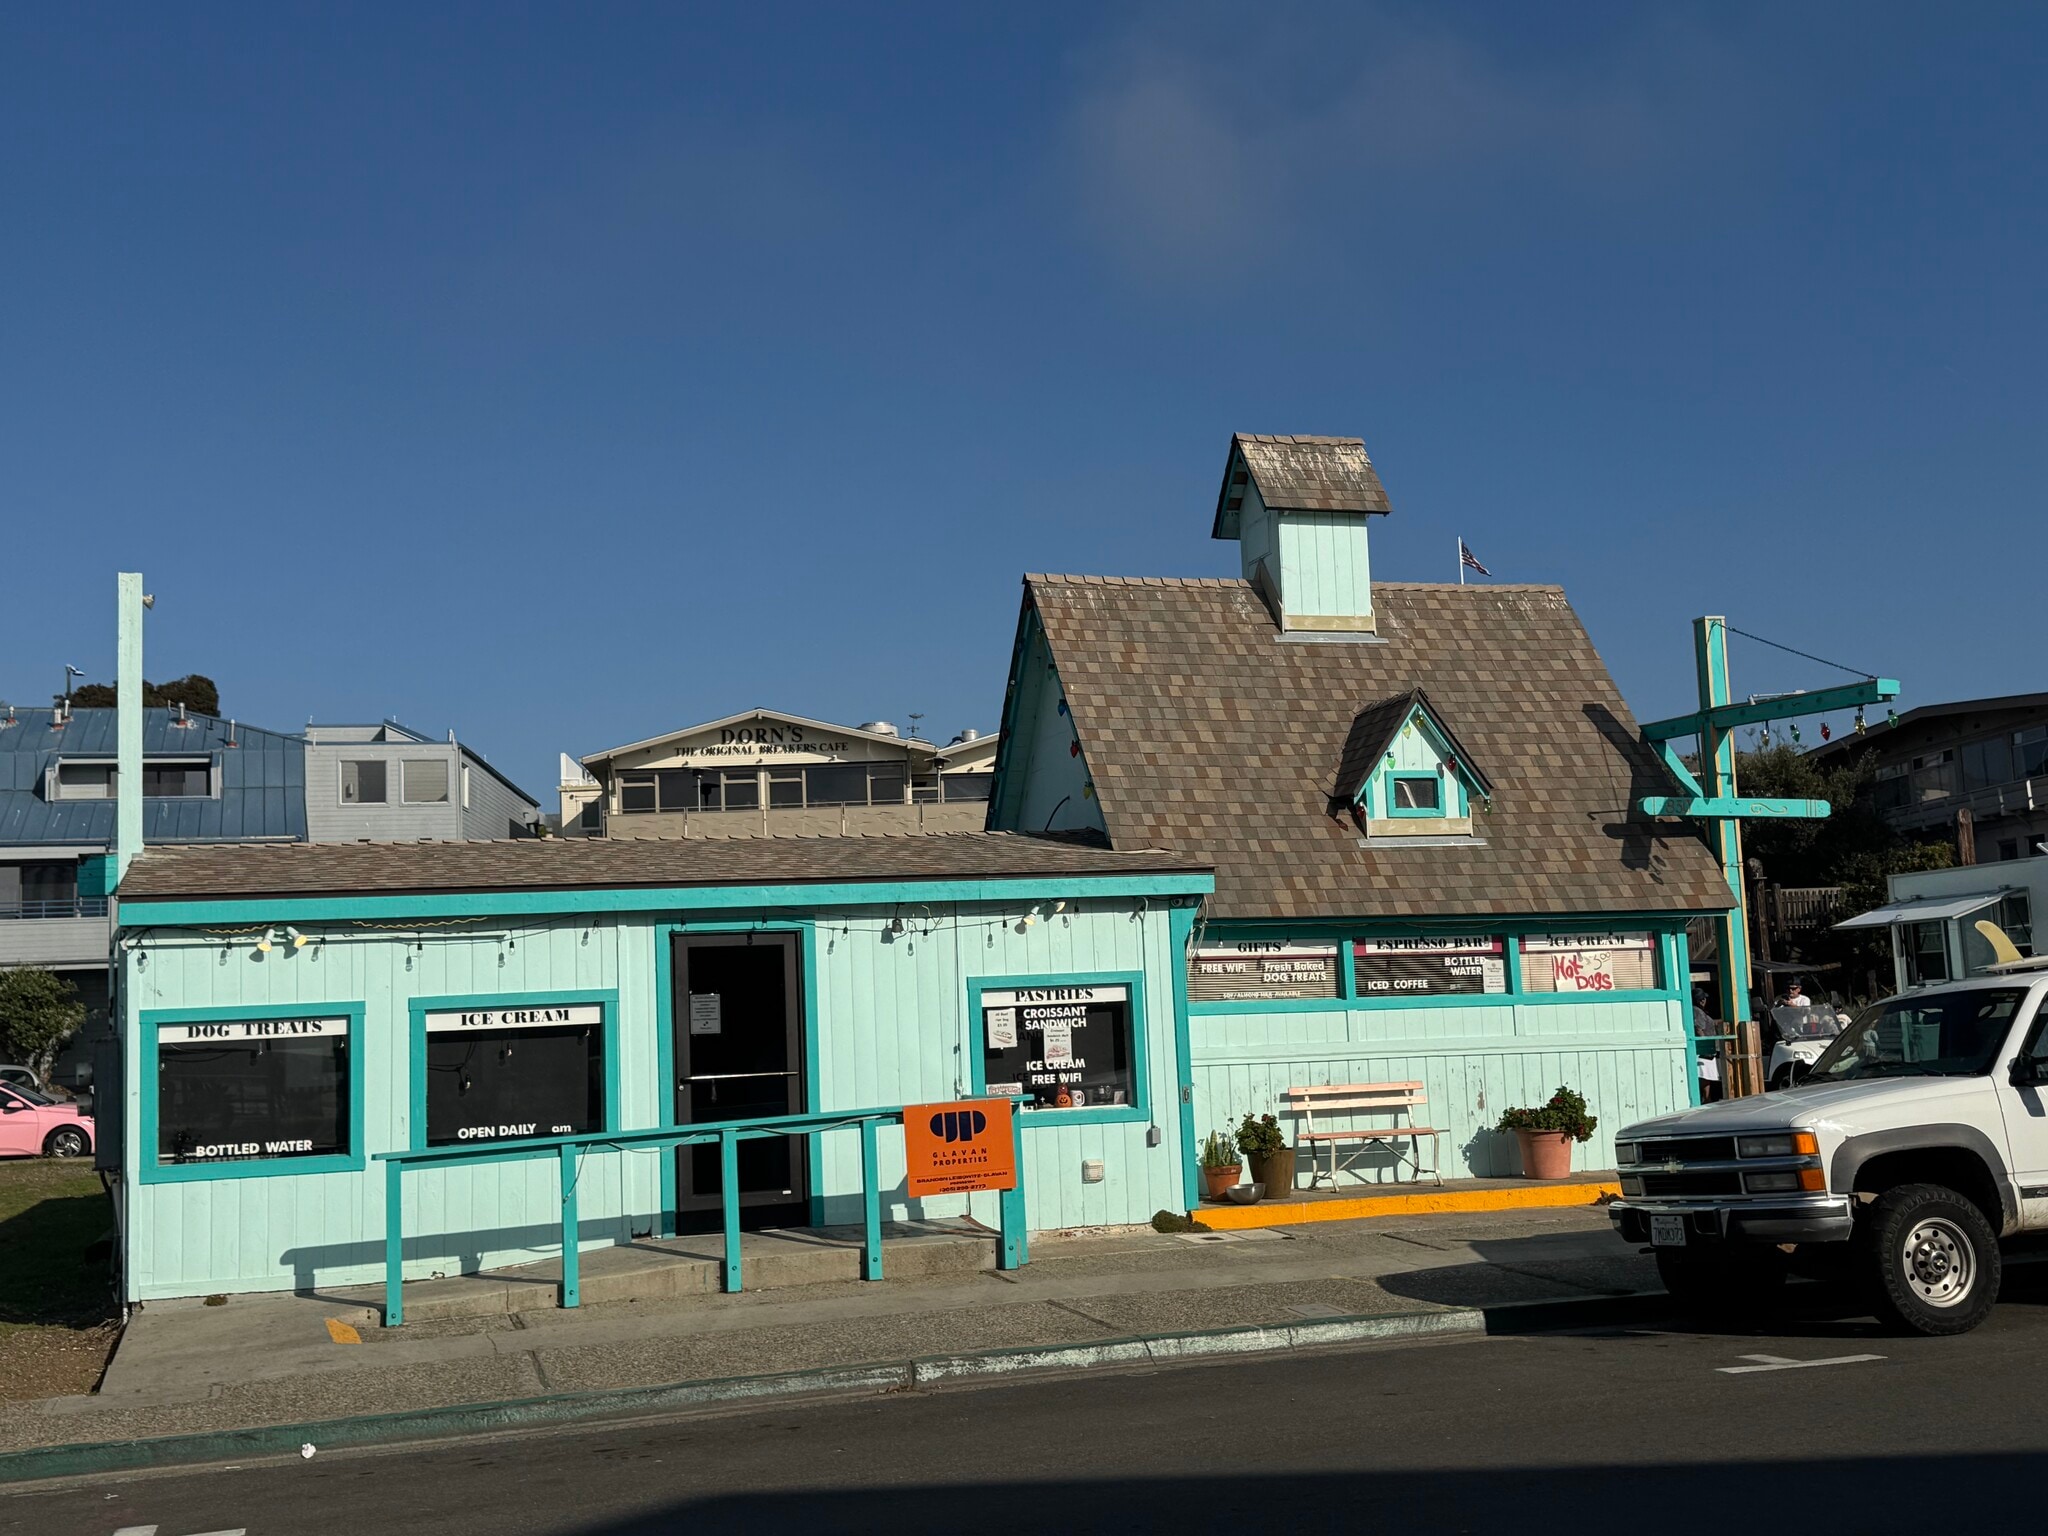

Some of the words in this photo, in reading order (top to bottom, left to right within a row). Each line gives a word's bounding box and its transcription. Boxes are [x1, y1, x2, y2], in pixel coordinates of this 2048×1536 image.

[720, 725, 803, 744] DORN'S
[674, 747, 697, 757] THE
[700, 745, 755, 757] ORIGINAL
[759, 743, 817, 754] BREAKERS
[819, 742, 848, 752] CAFE
[1238, 942, 1282, 953] GIFTS
[1376, 937, 1446, 950] ESPRESSO
[1453, 937, 1483, 948] BAR
[1549, 936, 1572, 947] ICE
[1577, 935, 1625, 946] CREAM
[1264, 962, 1292, 972] Fresh
[1294, 961, 1324, 971] Baked
[1444, 956, 1487, 966] BOTTLED
[1554, 954, 1583, 980] Hot
[1201, 964, 1224, 973] FREE
[1227, 963, 1246, 972] WIFI
[1450, 966, 1482, 976] WATER
[1264, 973, 1286, 982] DOG
[1292, 972, 1327, 981] TREATS
[1575, 972, 1613, 991] Dogs
[1368, 981, 1389, 990] ICED
[1394, 980, 1428, 989] COFFEE
[1015, 988, 1094, 1002] PASTRIES
[461, 1013, 493, 1026] ICE
[501, 1010, 570, 1024] CREAM
[1023, 1006, 1087, 1019] CROISSANT
[187, 1024, 230, 1038] DOG
[241, 1020, 322, 1036] TREATS
[1025, 1018, 1087, 1030] SANDWICH
[1026, 1061, 1043, 1071] ICE
[1046, 1058, 1086, 1070] CREAM
[1032, 1074, 1056, 1085] FREE
[1059, 1072, 1082, 1083] WIFI
[457, 1126, 495, 1139] OPEN
[499, 1123, 537, 1136] DAILY
[551, 1125, 571, 1133] am
[196, 1143, 259, 1157] BOTTLED
[265, 1139, 313, 1153] WATER
[932, 1148, 987, 1158] GLAVAN
[933, 1156, 988, 1166] PROPERTIES
